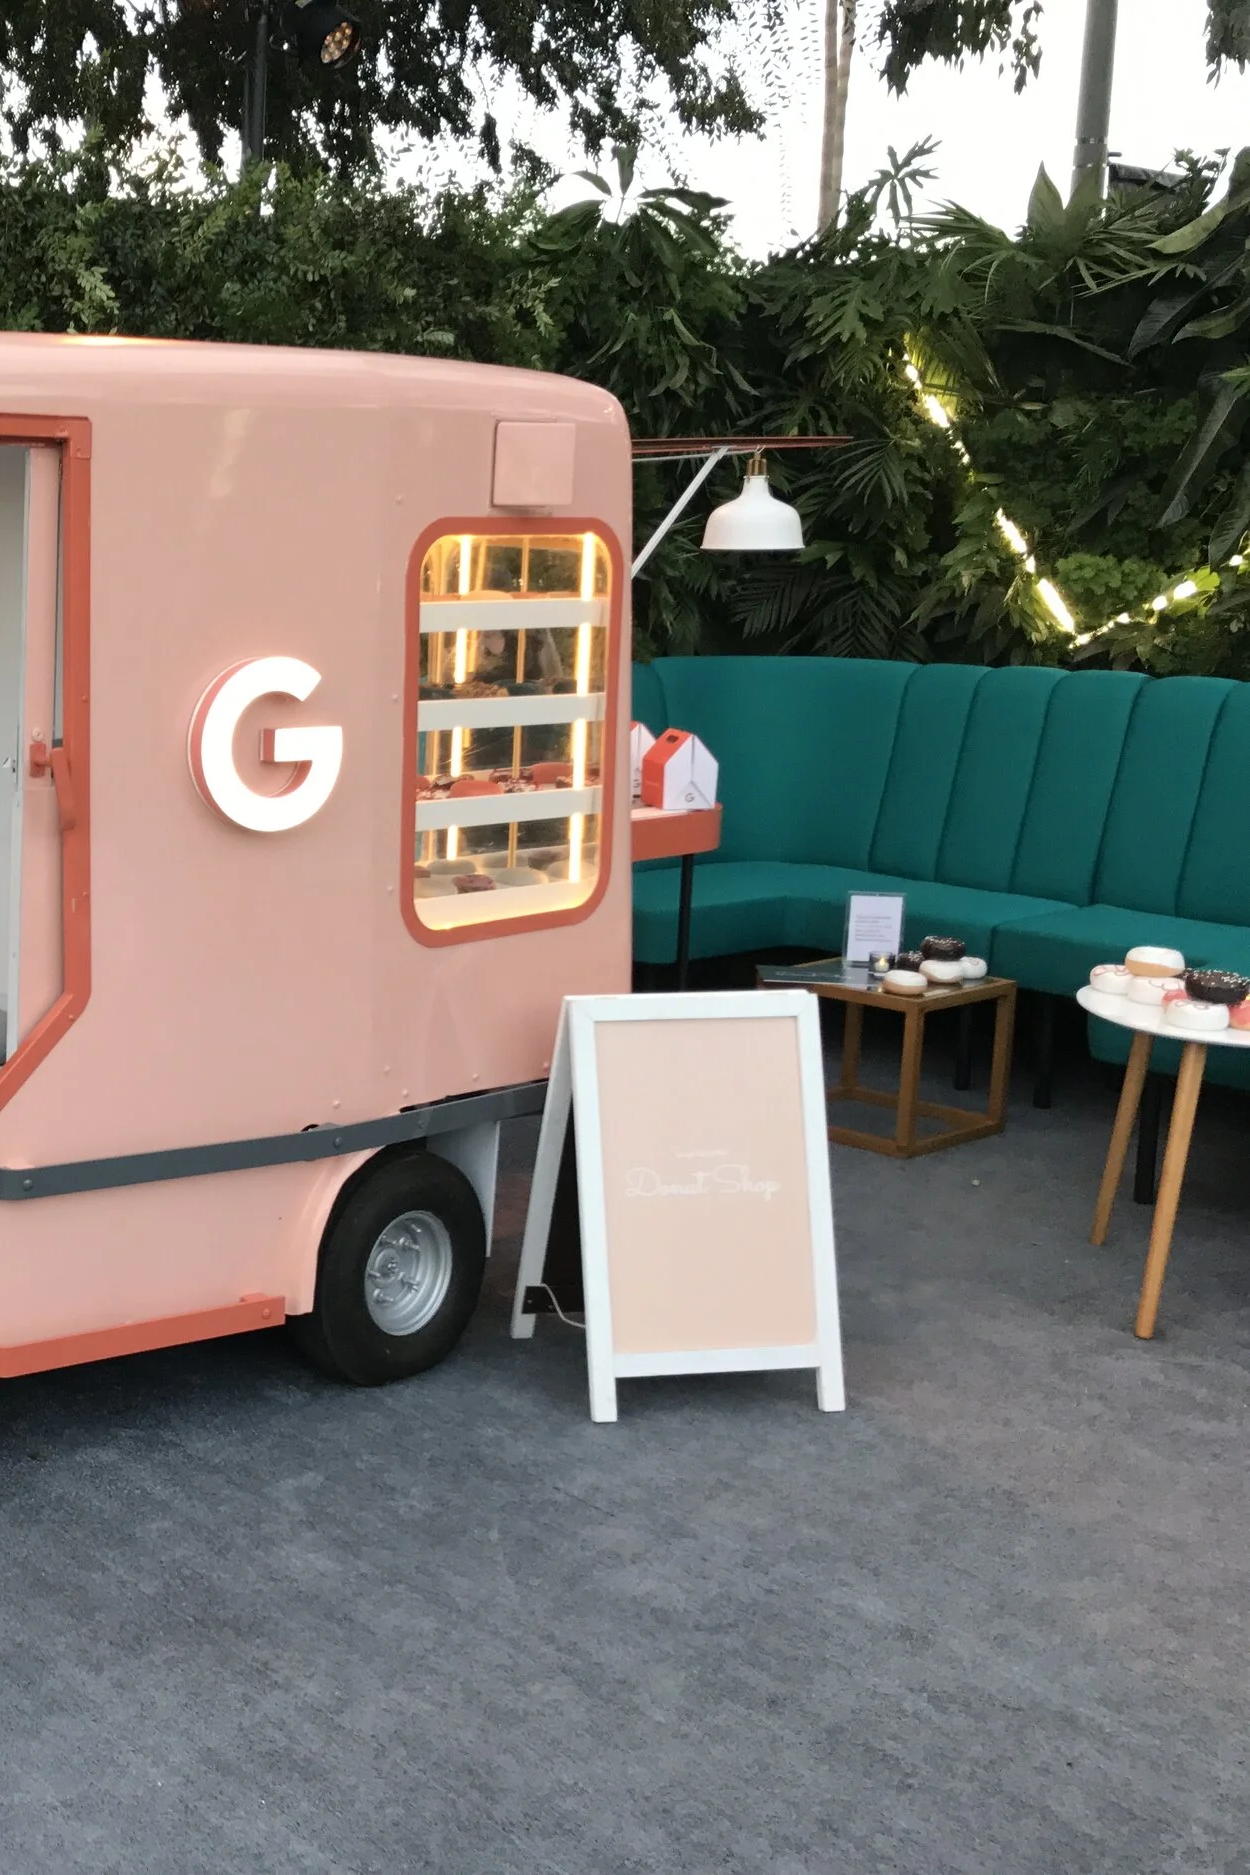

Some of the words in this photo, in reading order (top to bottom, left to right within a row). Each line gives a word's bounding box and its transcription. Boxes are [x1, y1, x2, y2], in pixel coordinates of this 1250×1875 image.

[190, 655, 344, 832] G
[625, 1167, 709, 1196] Donut
[714, 1164, 781, 1201] Shop
